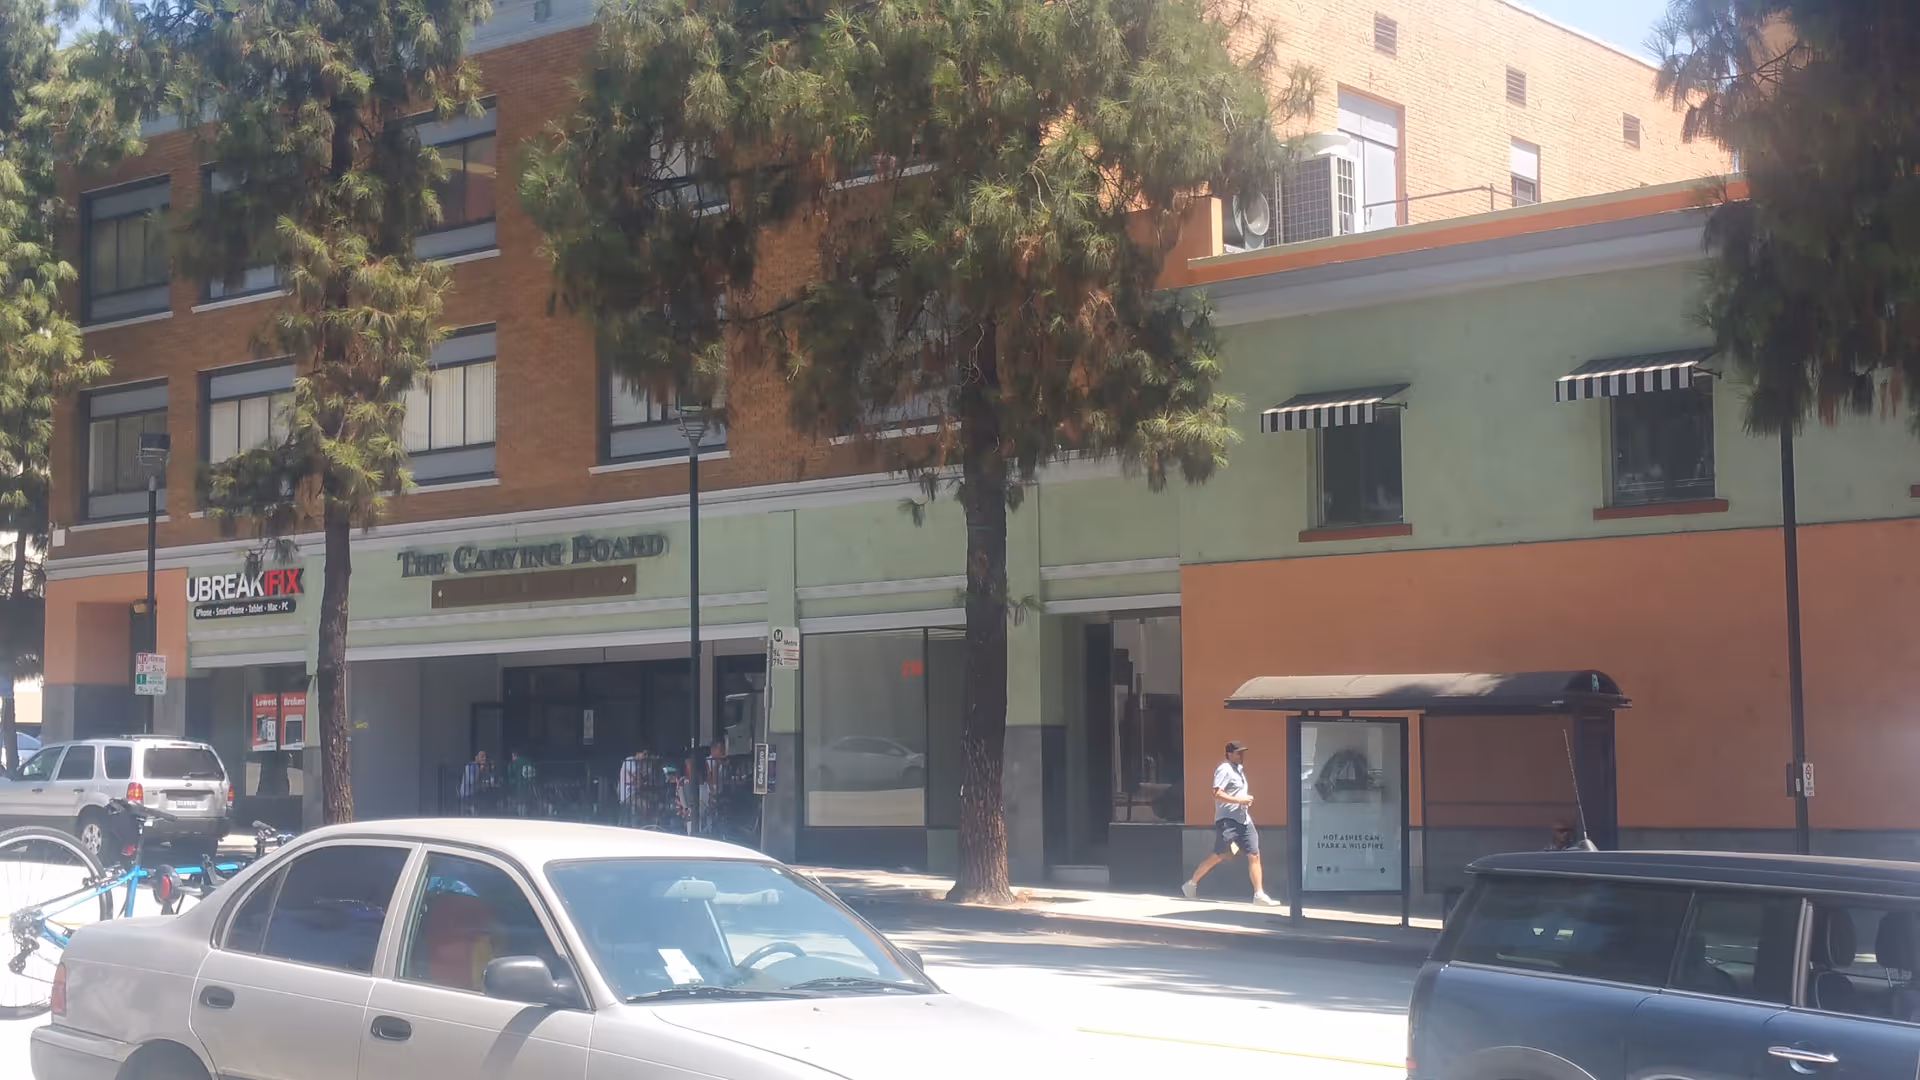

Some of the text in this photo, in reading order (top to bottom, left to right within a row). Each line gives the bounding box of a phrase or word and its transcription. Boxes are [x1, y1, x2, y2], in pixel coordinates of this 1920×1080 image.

[453, 545, 564, 573] CARVING
[571, 534, 667, 565] BOARD
[195, 601, 288, 617] iPhone SmartPhone Tablet Mac PC
[256, 698, 277, 707] Lowest
